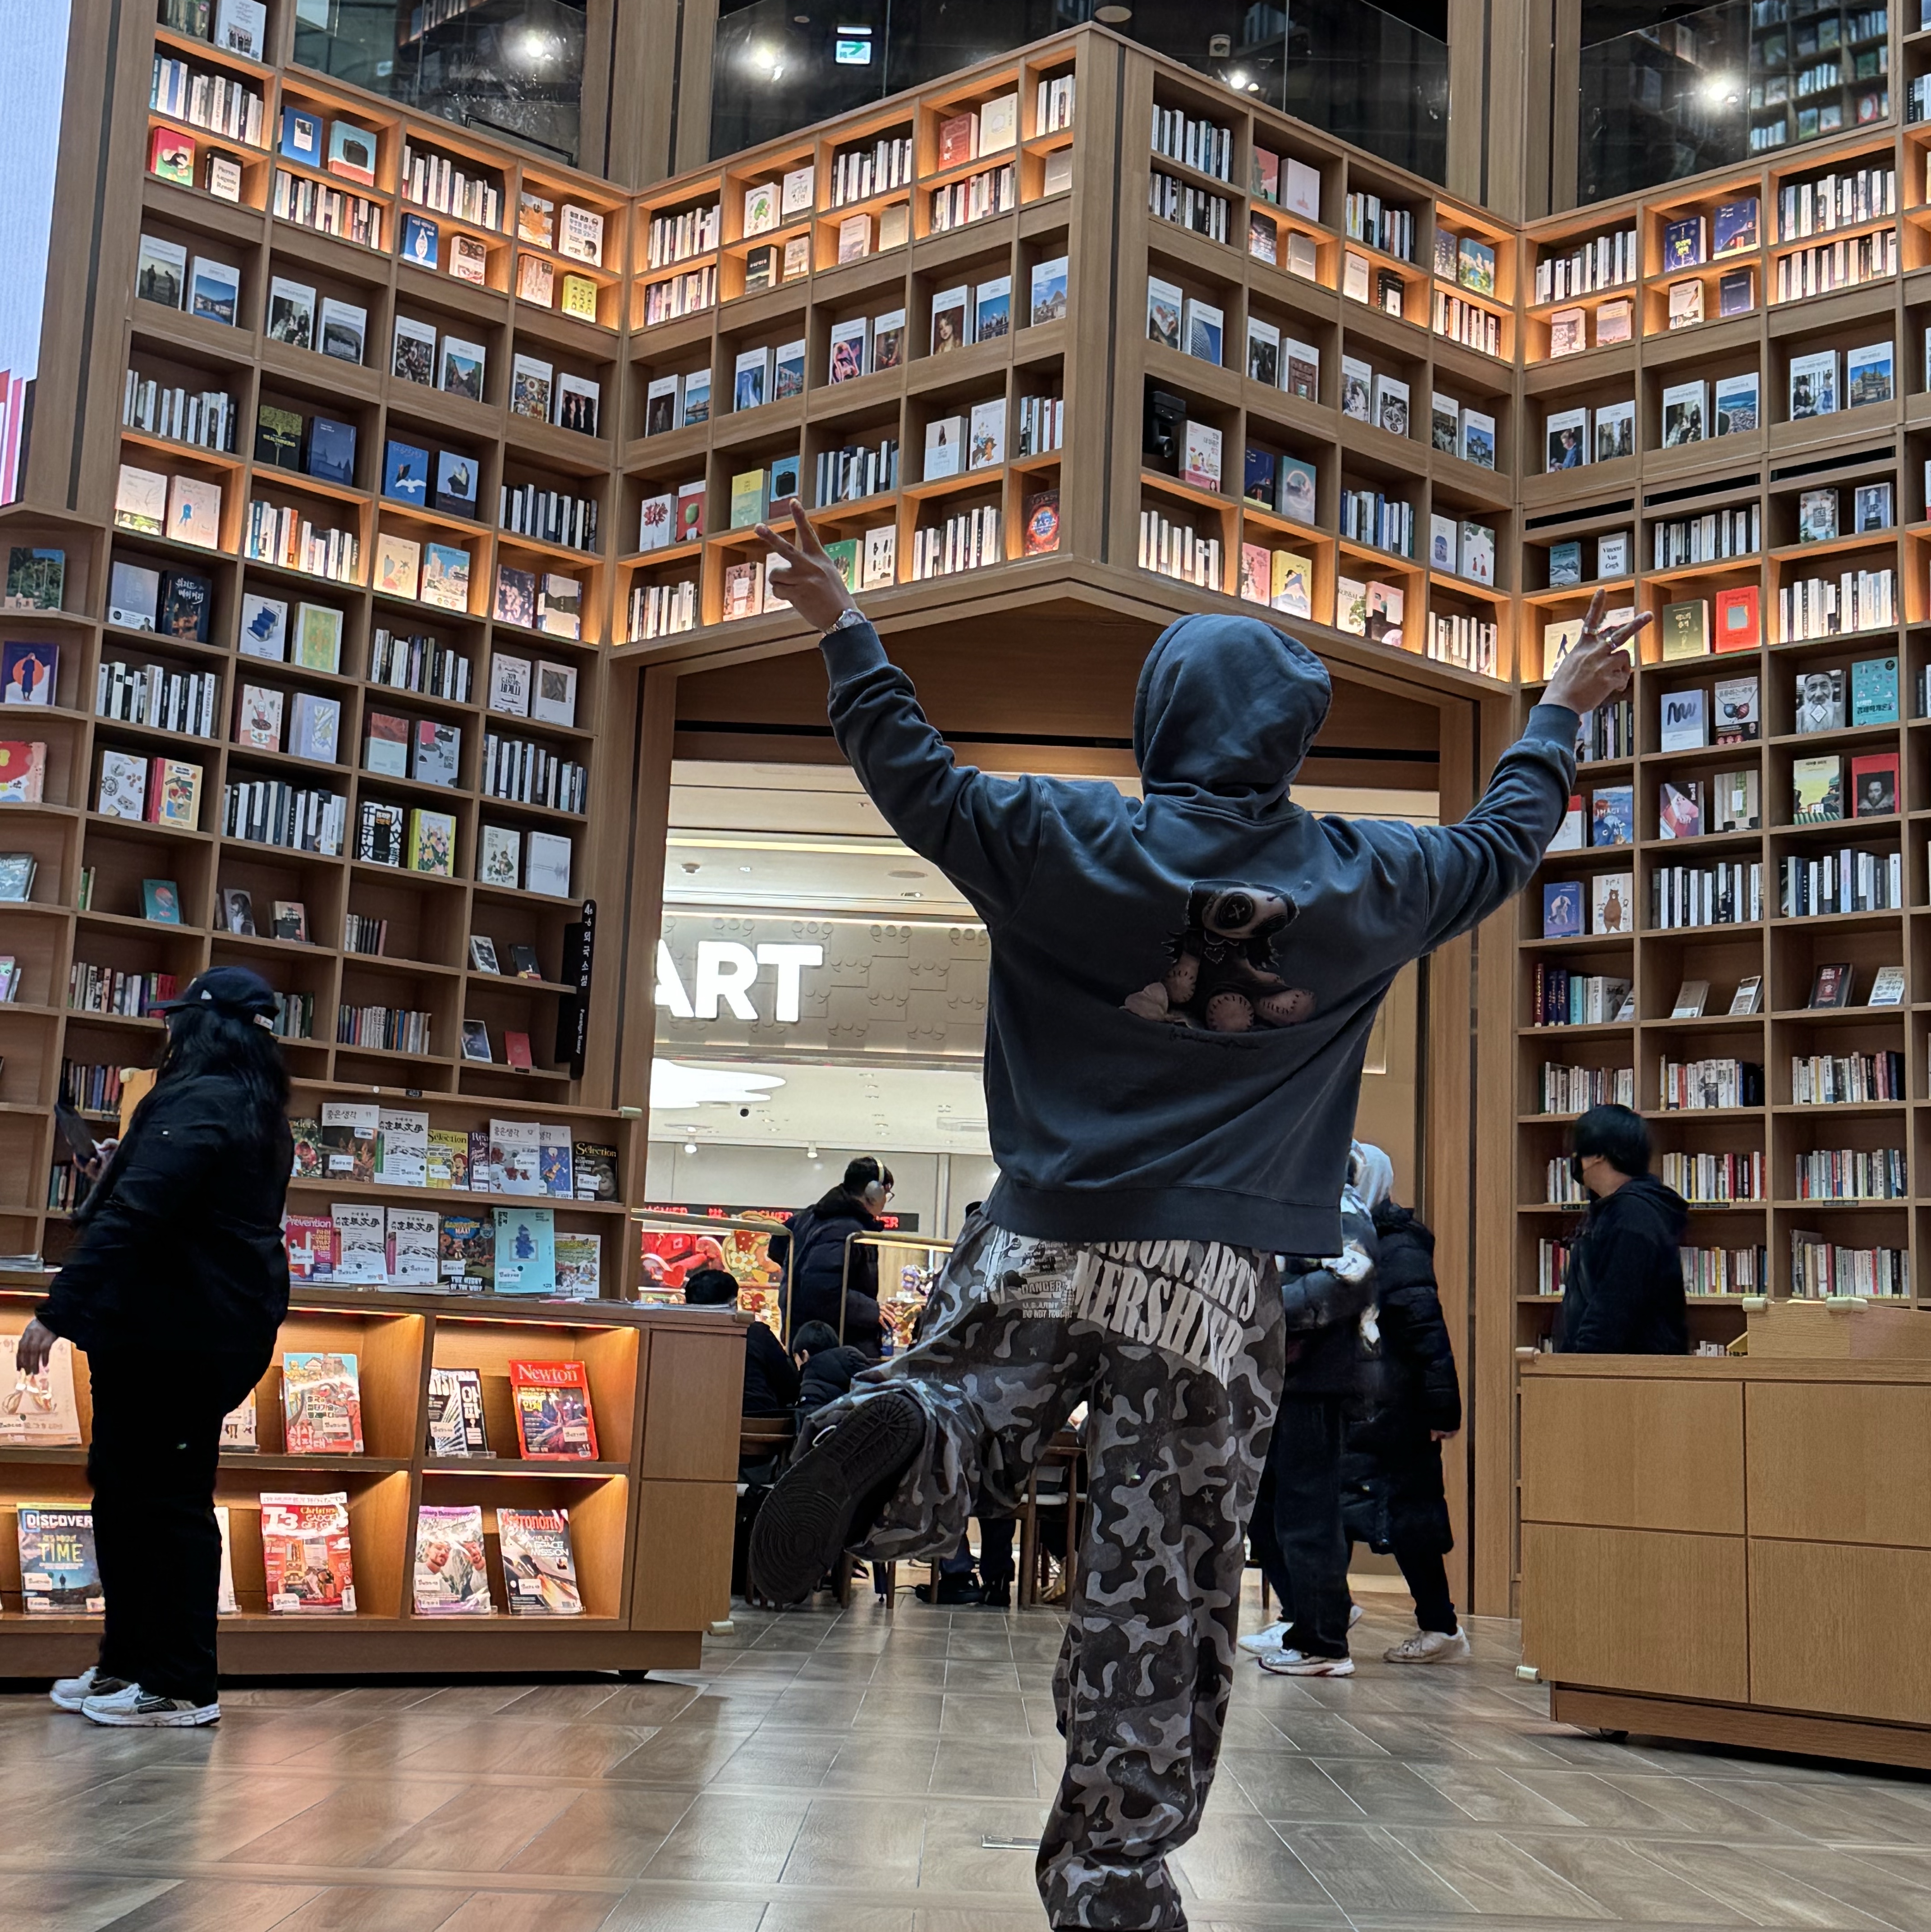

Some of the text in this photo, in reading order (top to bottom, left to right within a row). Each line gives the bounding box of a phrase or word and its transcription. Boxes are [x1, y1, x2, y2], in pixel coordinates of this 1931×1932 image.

[581, 931, 591, 987] 외국소설
[655, 939, 823, 1022] ART
[575, 1143, 616, 1157] Selection
[1021, 1280, 1063, 1294] DANGER
[517, 1364, 578, 1381] Newton
[27, 1514, 93, 1527] DISCOVER
[263, 1507, 298, 1528] T3
[37, 1543, 83, 1562] TIME
[531, 1548, 569, 1556] MISSION
